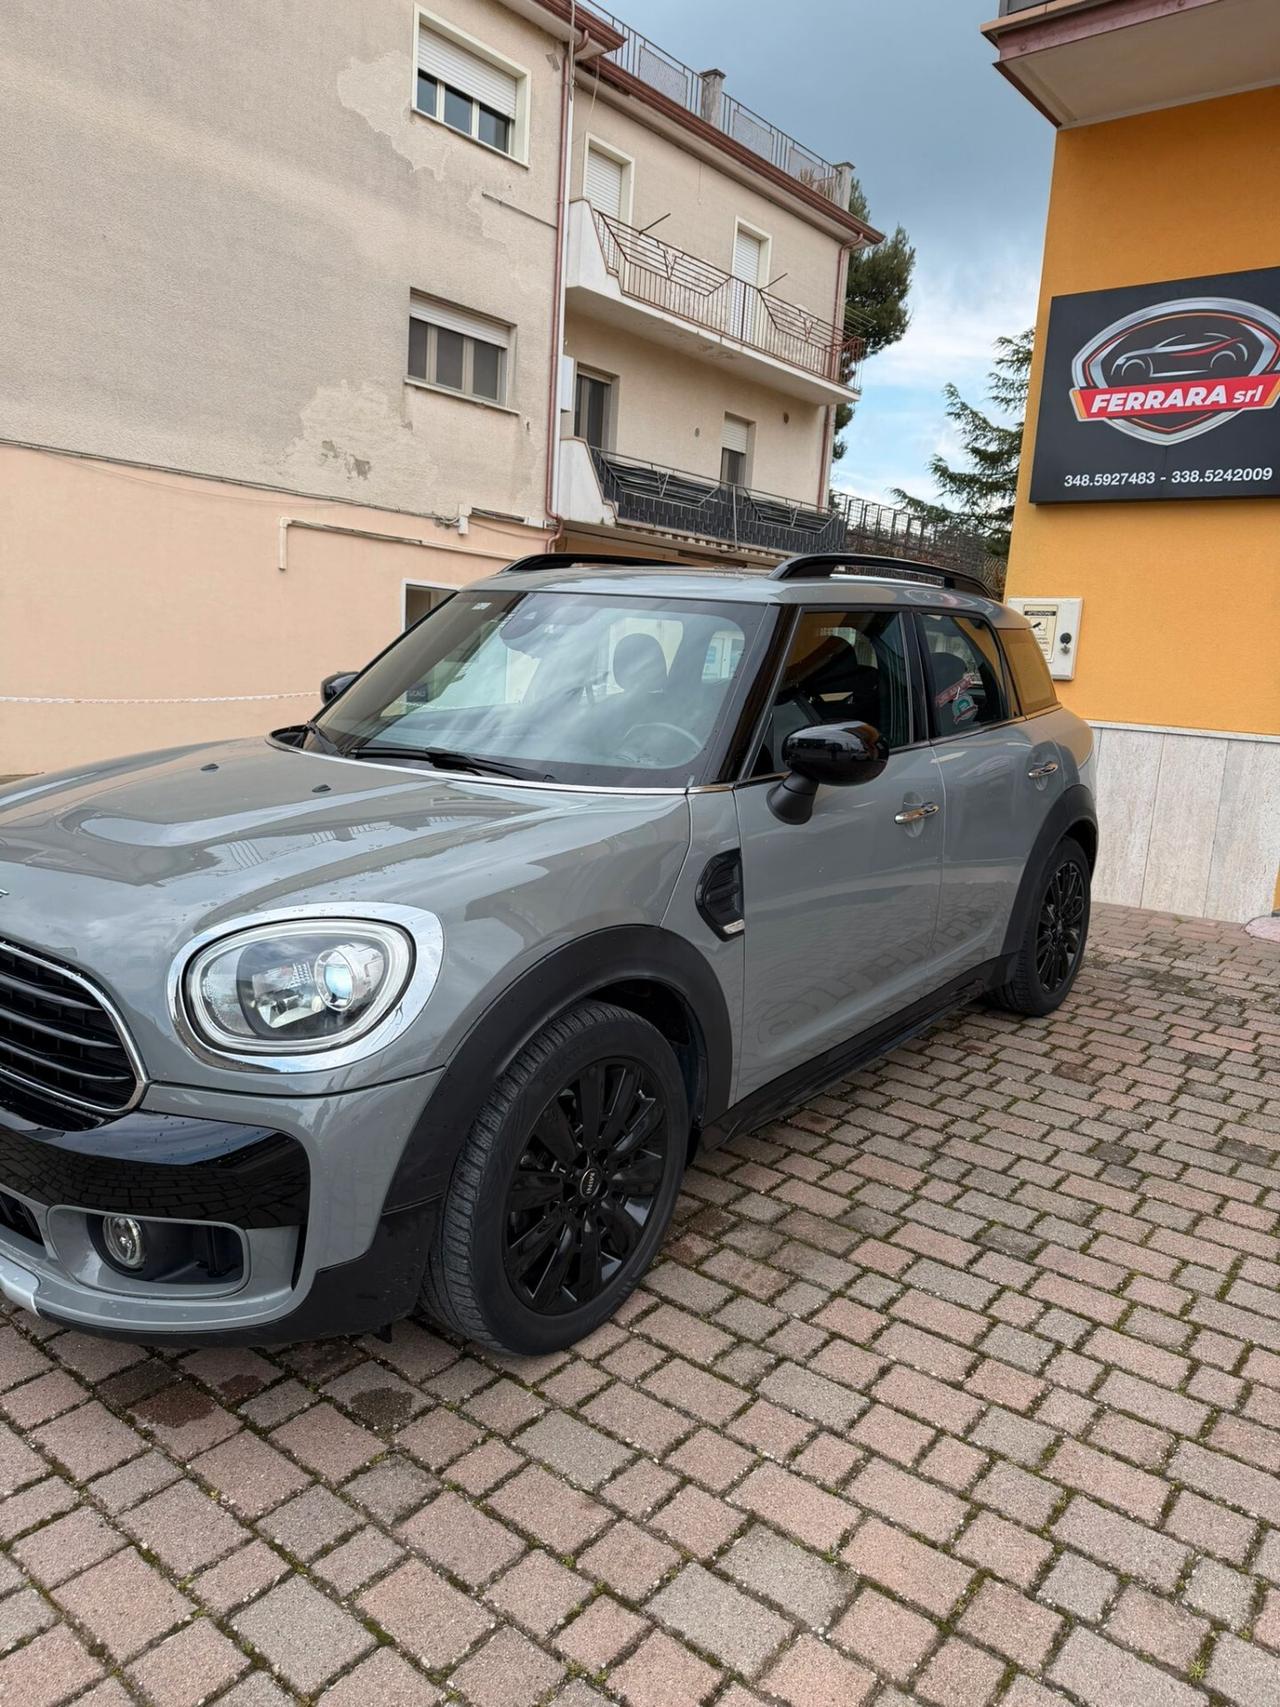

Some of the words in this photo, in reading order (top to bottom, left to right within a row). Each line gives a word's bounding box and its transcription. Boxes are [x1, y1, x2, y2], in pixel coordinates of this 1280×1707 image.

[1090, 385, 1227, 413] FERRARA
[1233, 385, 1264, 403] srl
[1064, 471, 1156, 487] 348.5927483
[1171, 467, 1273, 483] 338.5242009
